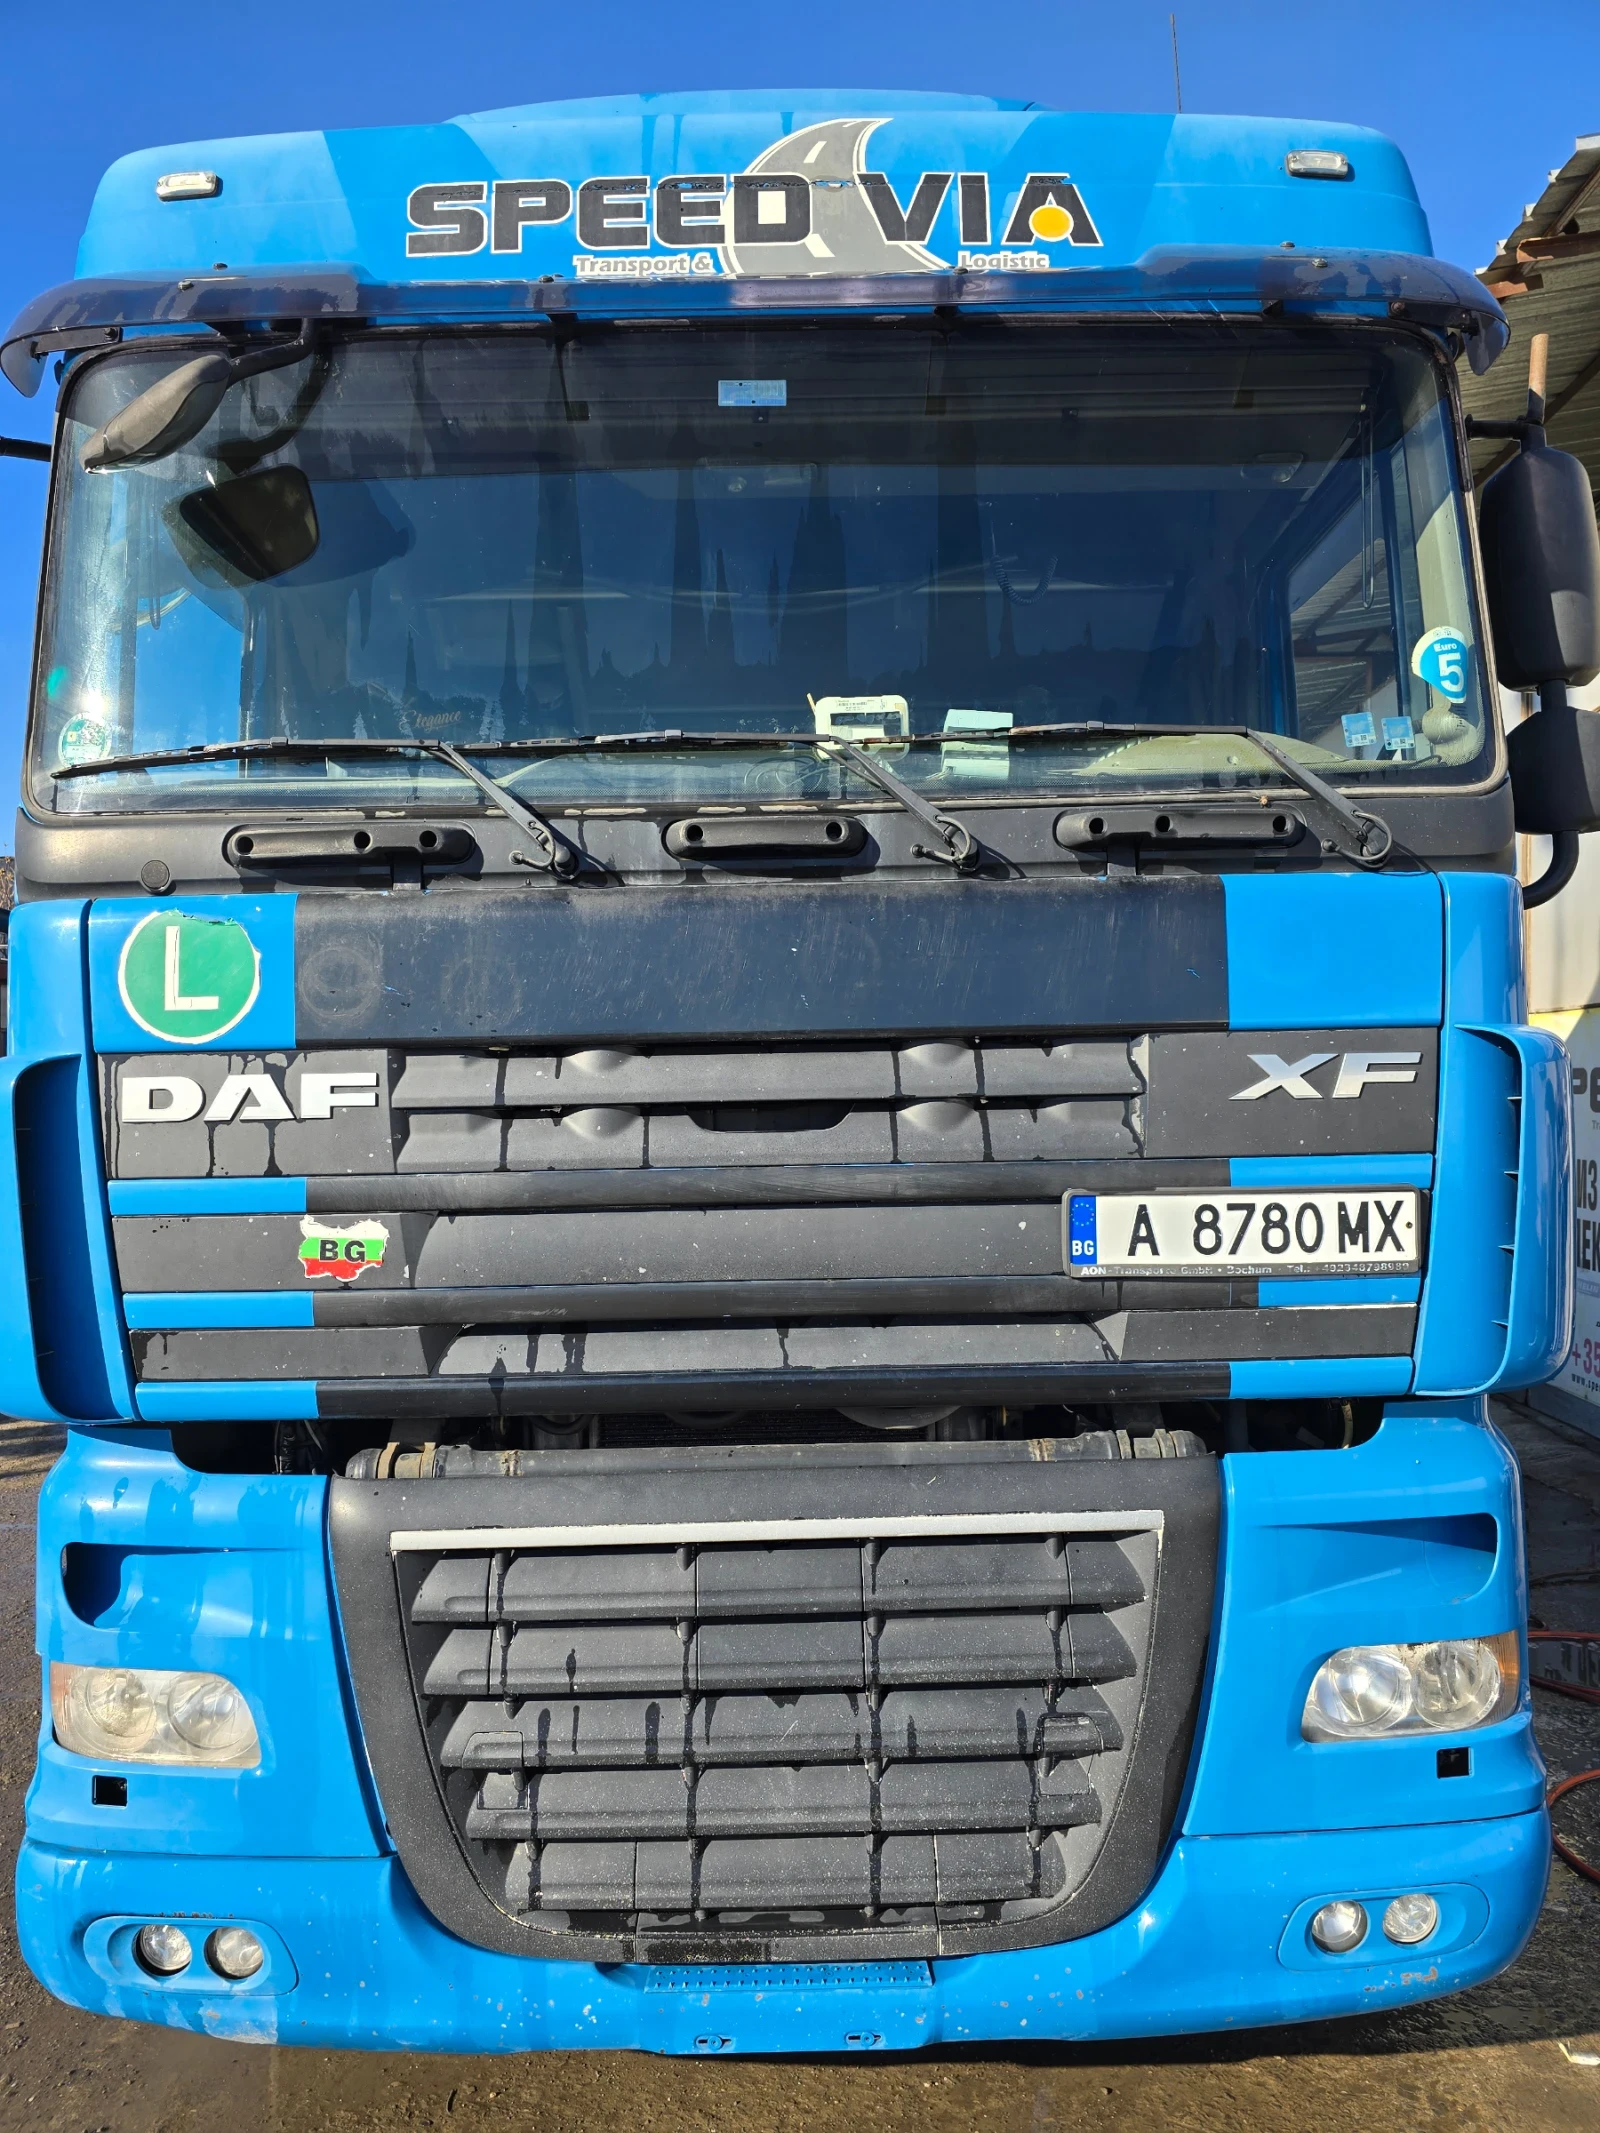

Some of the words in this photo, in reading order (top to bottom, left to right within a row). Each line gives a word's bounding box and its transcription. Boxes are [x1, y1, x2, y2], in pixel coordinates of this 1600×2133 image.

[406, 171, 812, 257] SPEED
[857, 171, 1103, 247] VIA
[575, 253, 688, 276] Transport
[693, 253, 713, 272] &
[961, 254, 1047, 271] Logistic
[1433, 642, 1458, 652] Euro
[1438, 652, 1465, 692] 5
[164, 925, 219, 1011] L
[1228, 1051, 1422, 1100] XF
[121, 1072, 378, 1123] DAF
[1072, 1239, 1095, 1256] BG
[1127, 1203, 1161, 1257] A
[1192, 1201, 1325, 1256] 8780
[1337, 1200, 1406, 1254] MX
[319, 1239, 367, 1263] BG
[1226, 1264, 1272, 1275] Bochum
